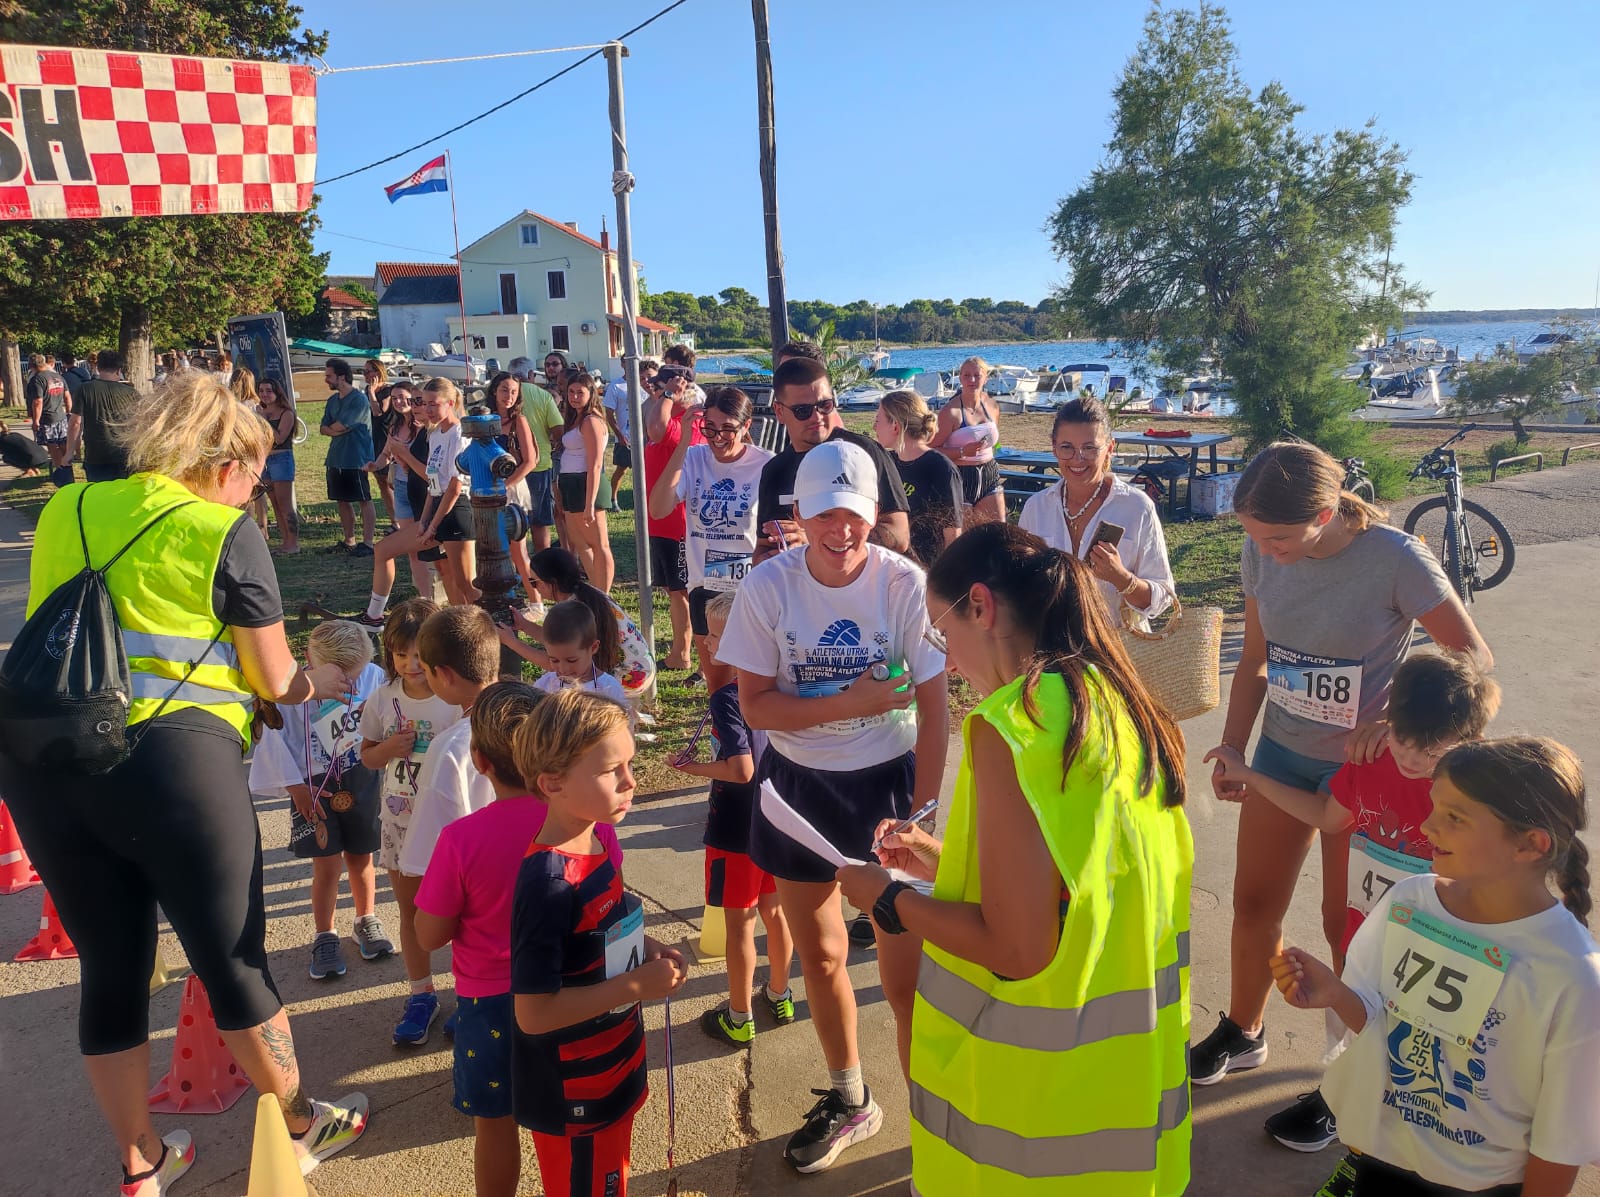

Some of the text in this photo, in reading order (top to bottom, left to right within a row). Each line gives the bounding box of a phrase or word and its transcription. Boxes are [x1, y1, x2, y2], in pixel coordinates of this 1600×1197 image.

[812, 647, 845, 657] ATLETSKA
[846, 647, 869, 656] UTRKA
[1302, 655, 1336, 666] ATLETSKA
[1302, 671, 1351, 704] 168
[1393, 947, 1469, 1013] 475
